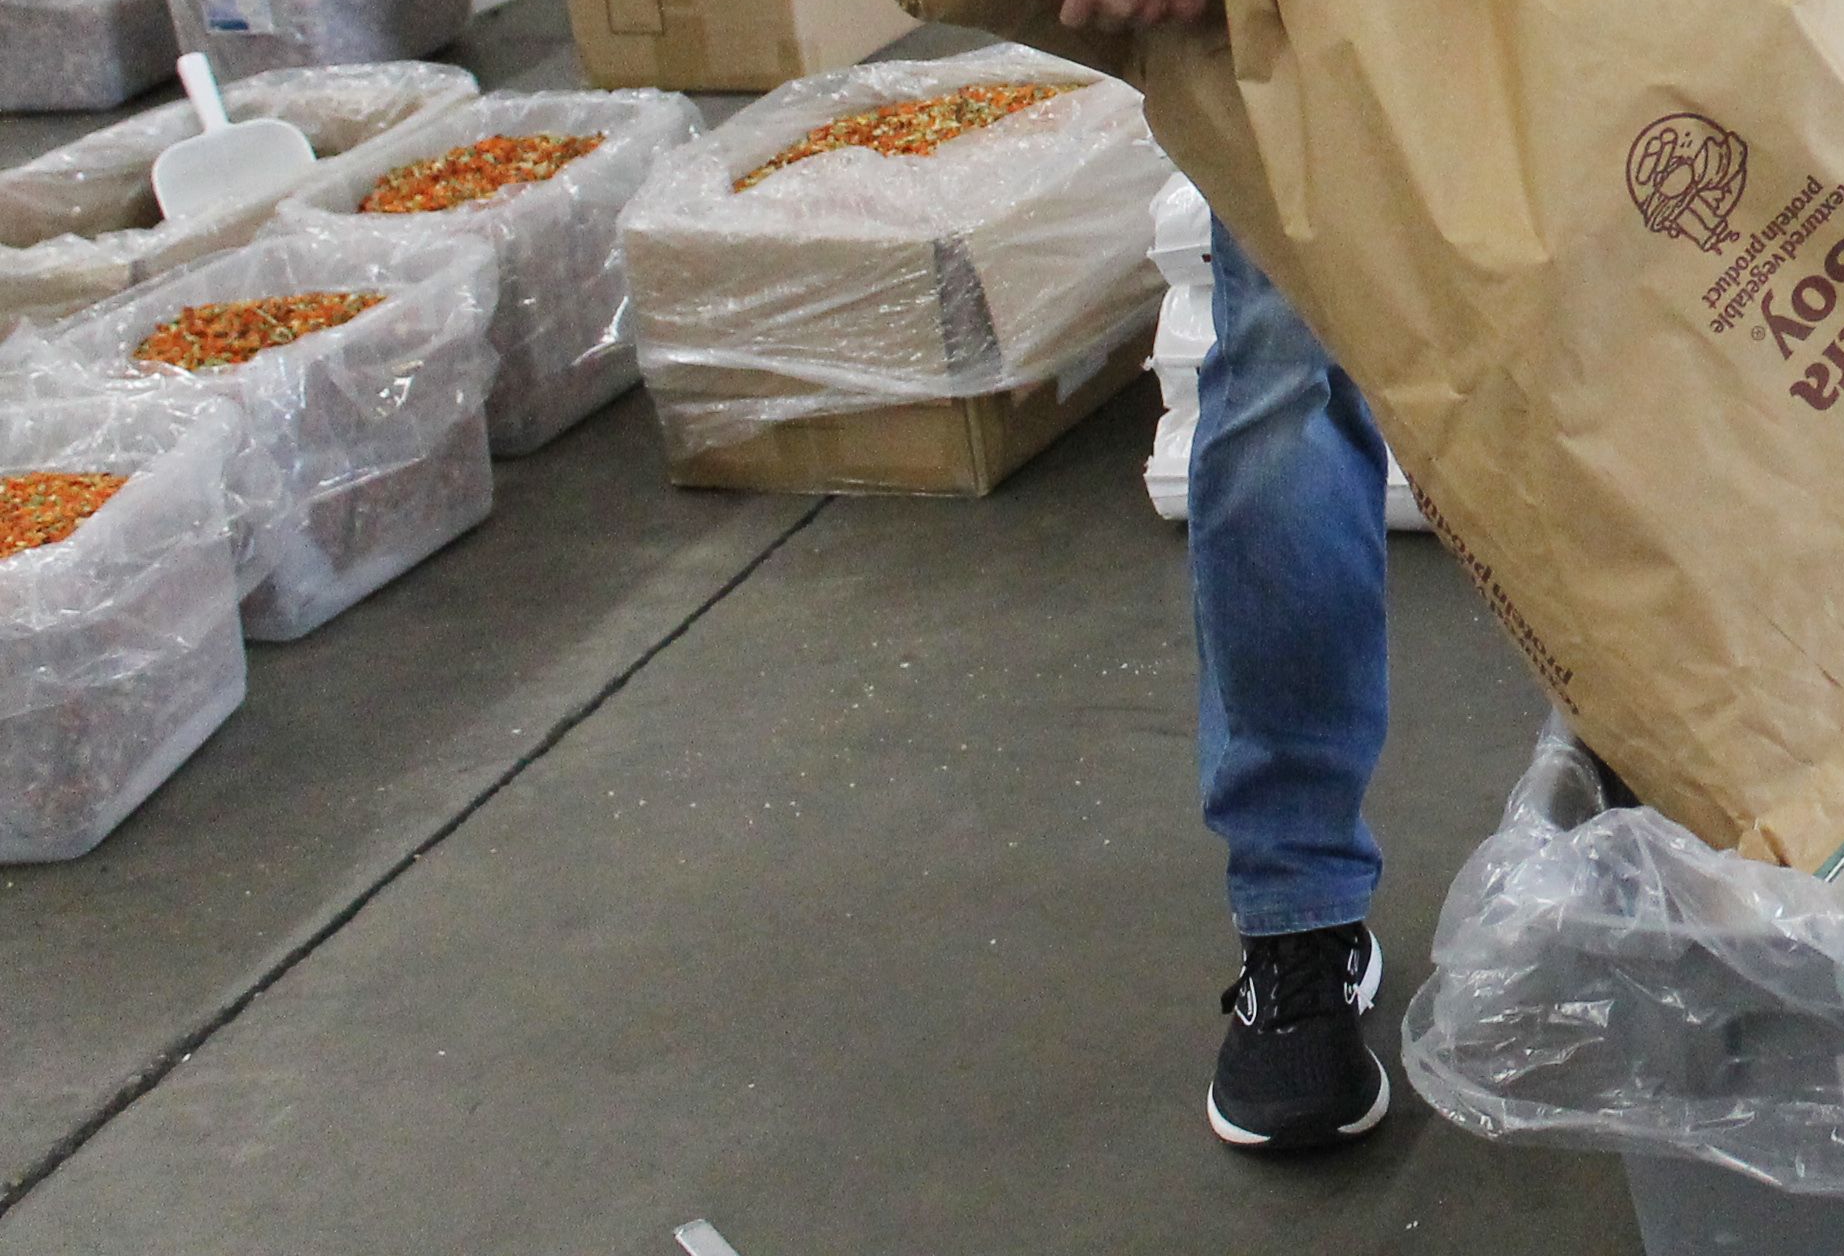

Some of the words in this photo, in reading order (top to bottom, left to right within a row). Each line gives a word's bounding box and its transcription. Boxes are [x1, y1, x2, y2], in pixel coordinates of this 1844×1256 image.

[1760, 174, 1824, 243] protein
[1700, 230, 1766, 310] product
[1708, 252, 1787, 334] vegetable
[1492, 582, 1575, 686] protein
